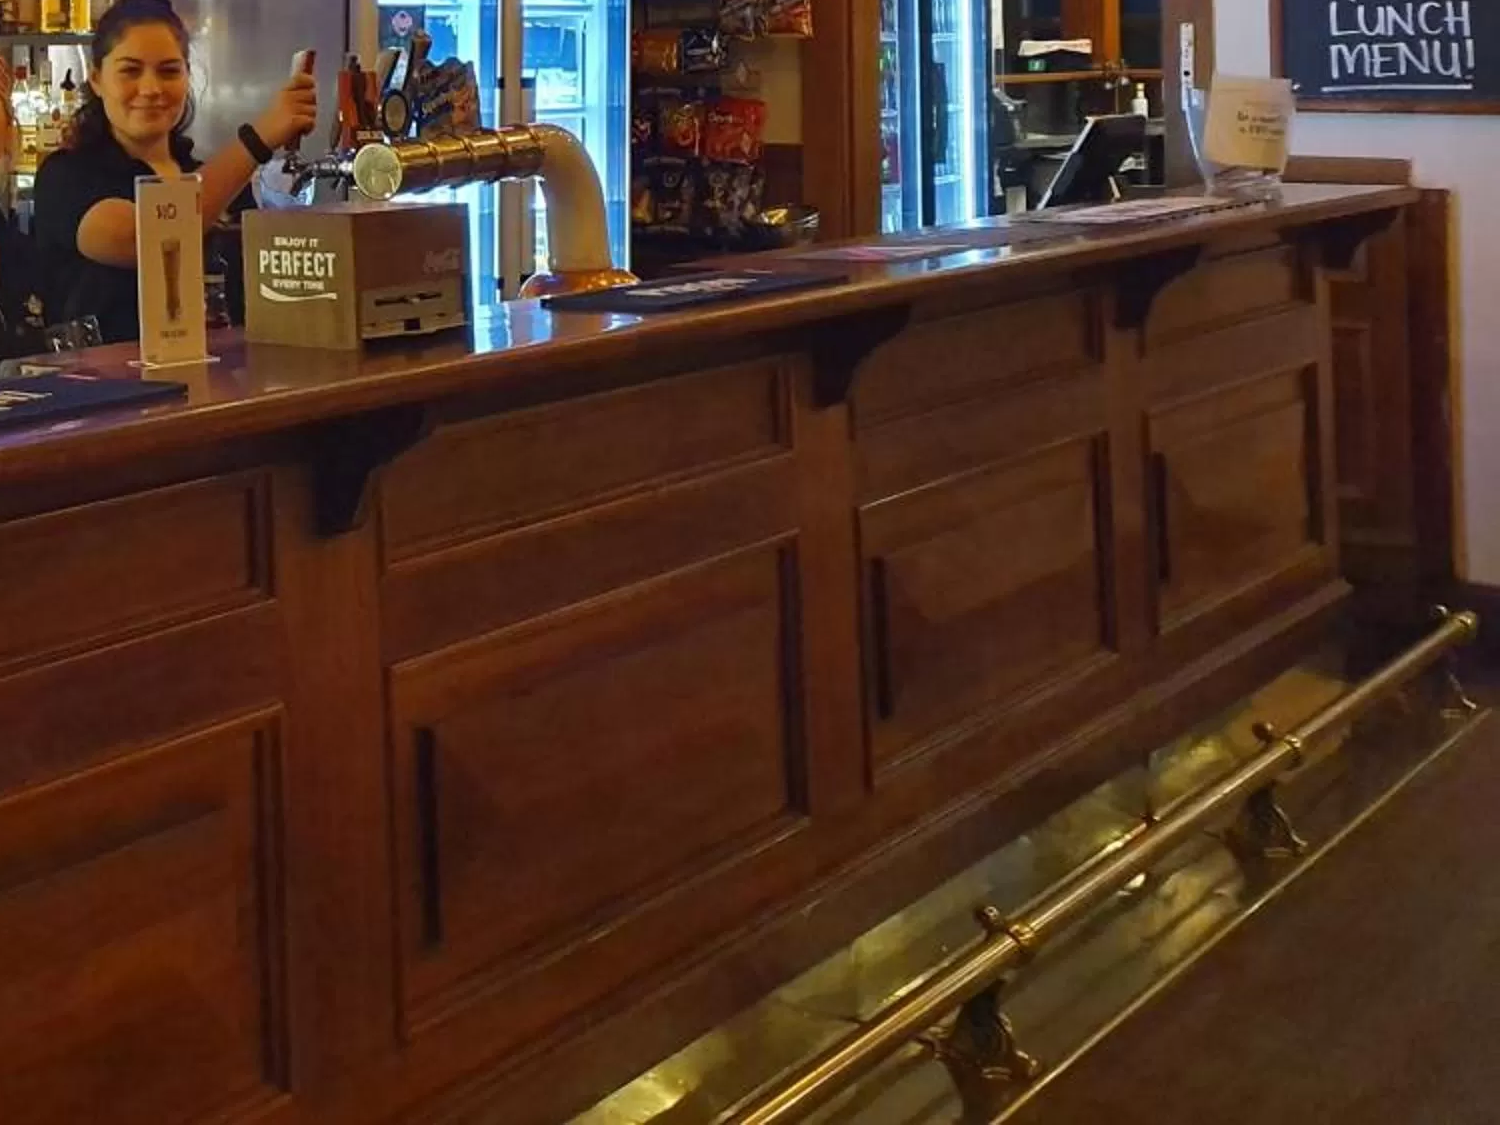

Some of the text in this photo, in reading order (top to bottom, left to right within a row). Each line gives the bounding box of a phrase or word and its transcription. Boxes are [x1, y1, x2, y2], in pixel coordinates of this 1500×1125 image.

[1329, 0, 1472, 38] LUNCH
[1331, 38, 1476, 80] MENU!
[273, 236, 319, 248] ENJOY IT
[259, 249, 337, 278] PERFECT
